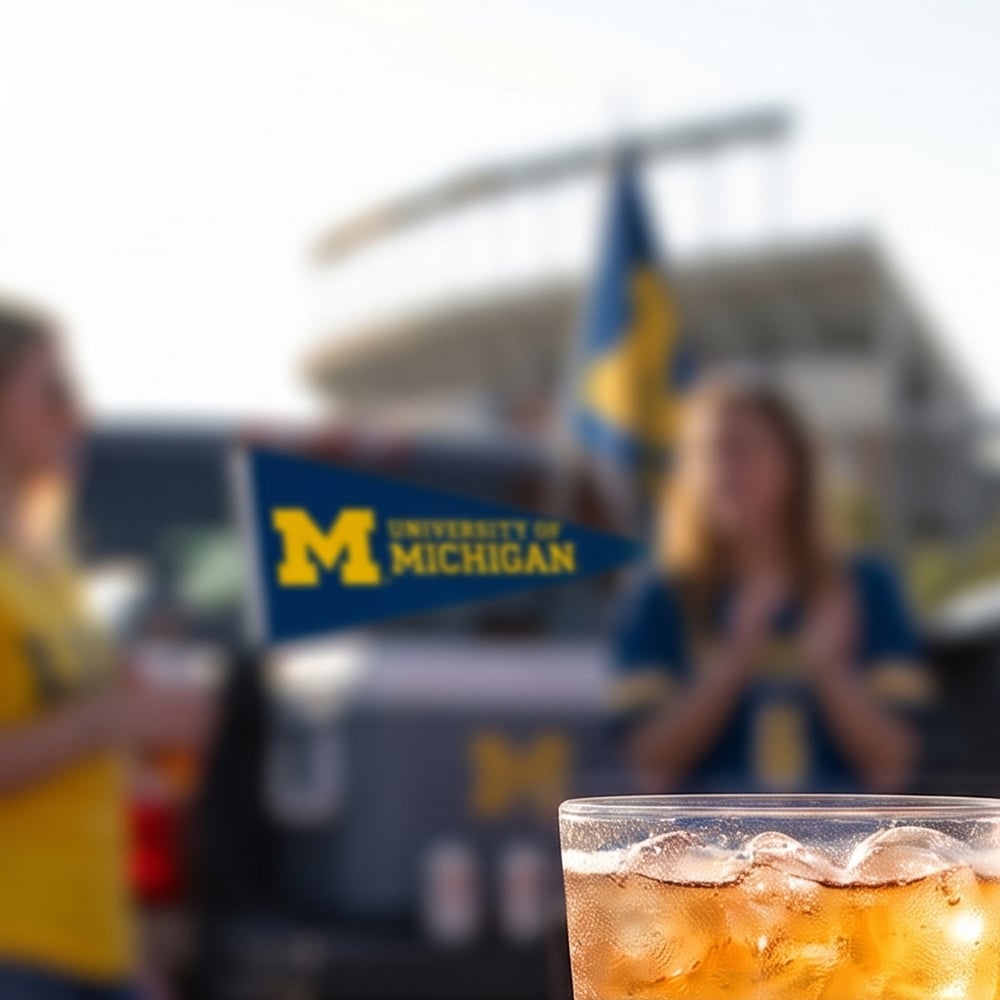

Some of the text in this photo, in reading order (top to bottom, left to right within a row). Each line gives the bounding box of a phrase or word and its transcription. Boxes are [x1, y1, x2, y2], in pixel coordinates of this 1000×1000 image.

[388, 519, 561, 538] UNIVERSITY OF
[272, 508, 382, 586] M
[391, 542, 576, 576] MICHIGAN
